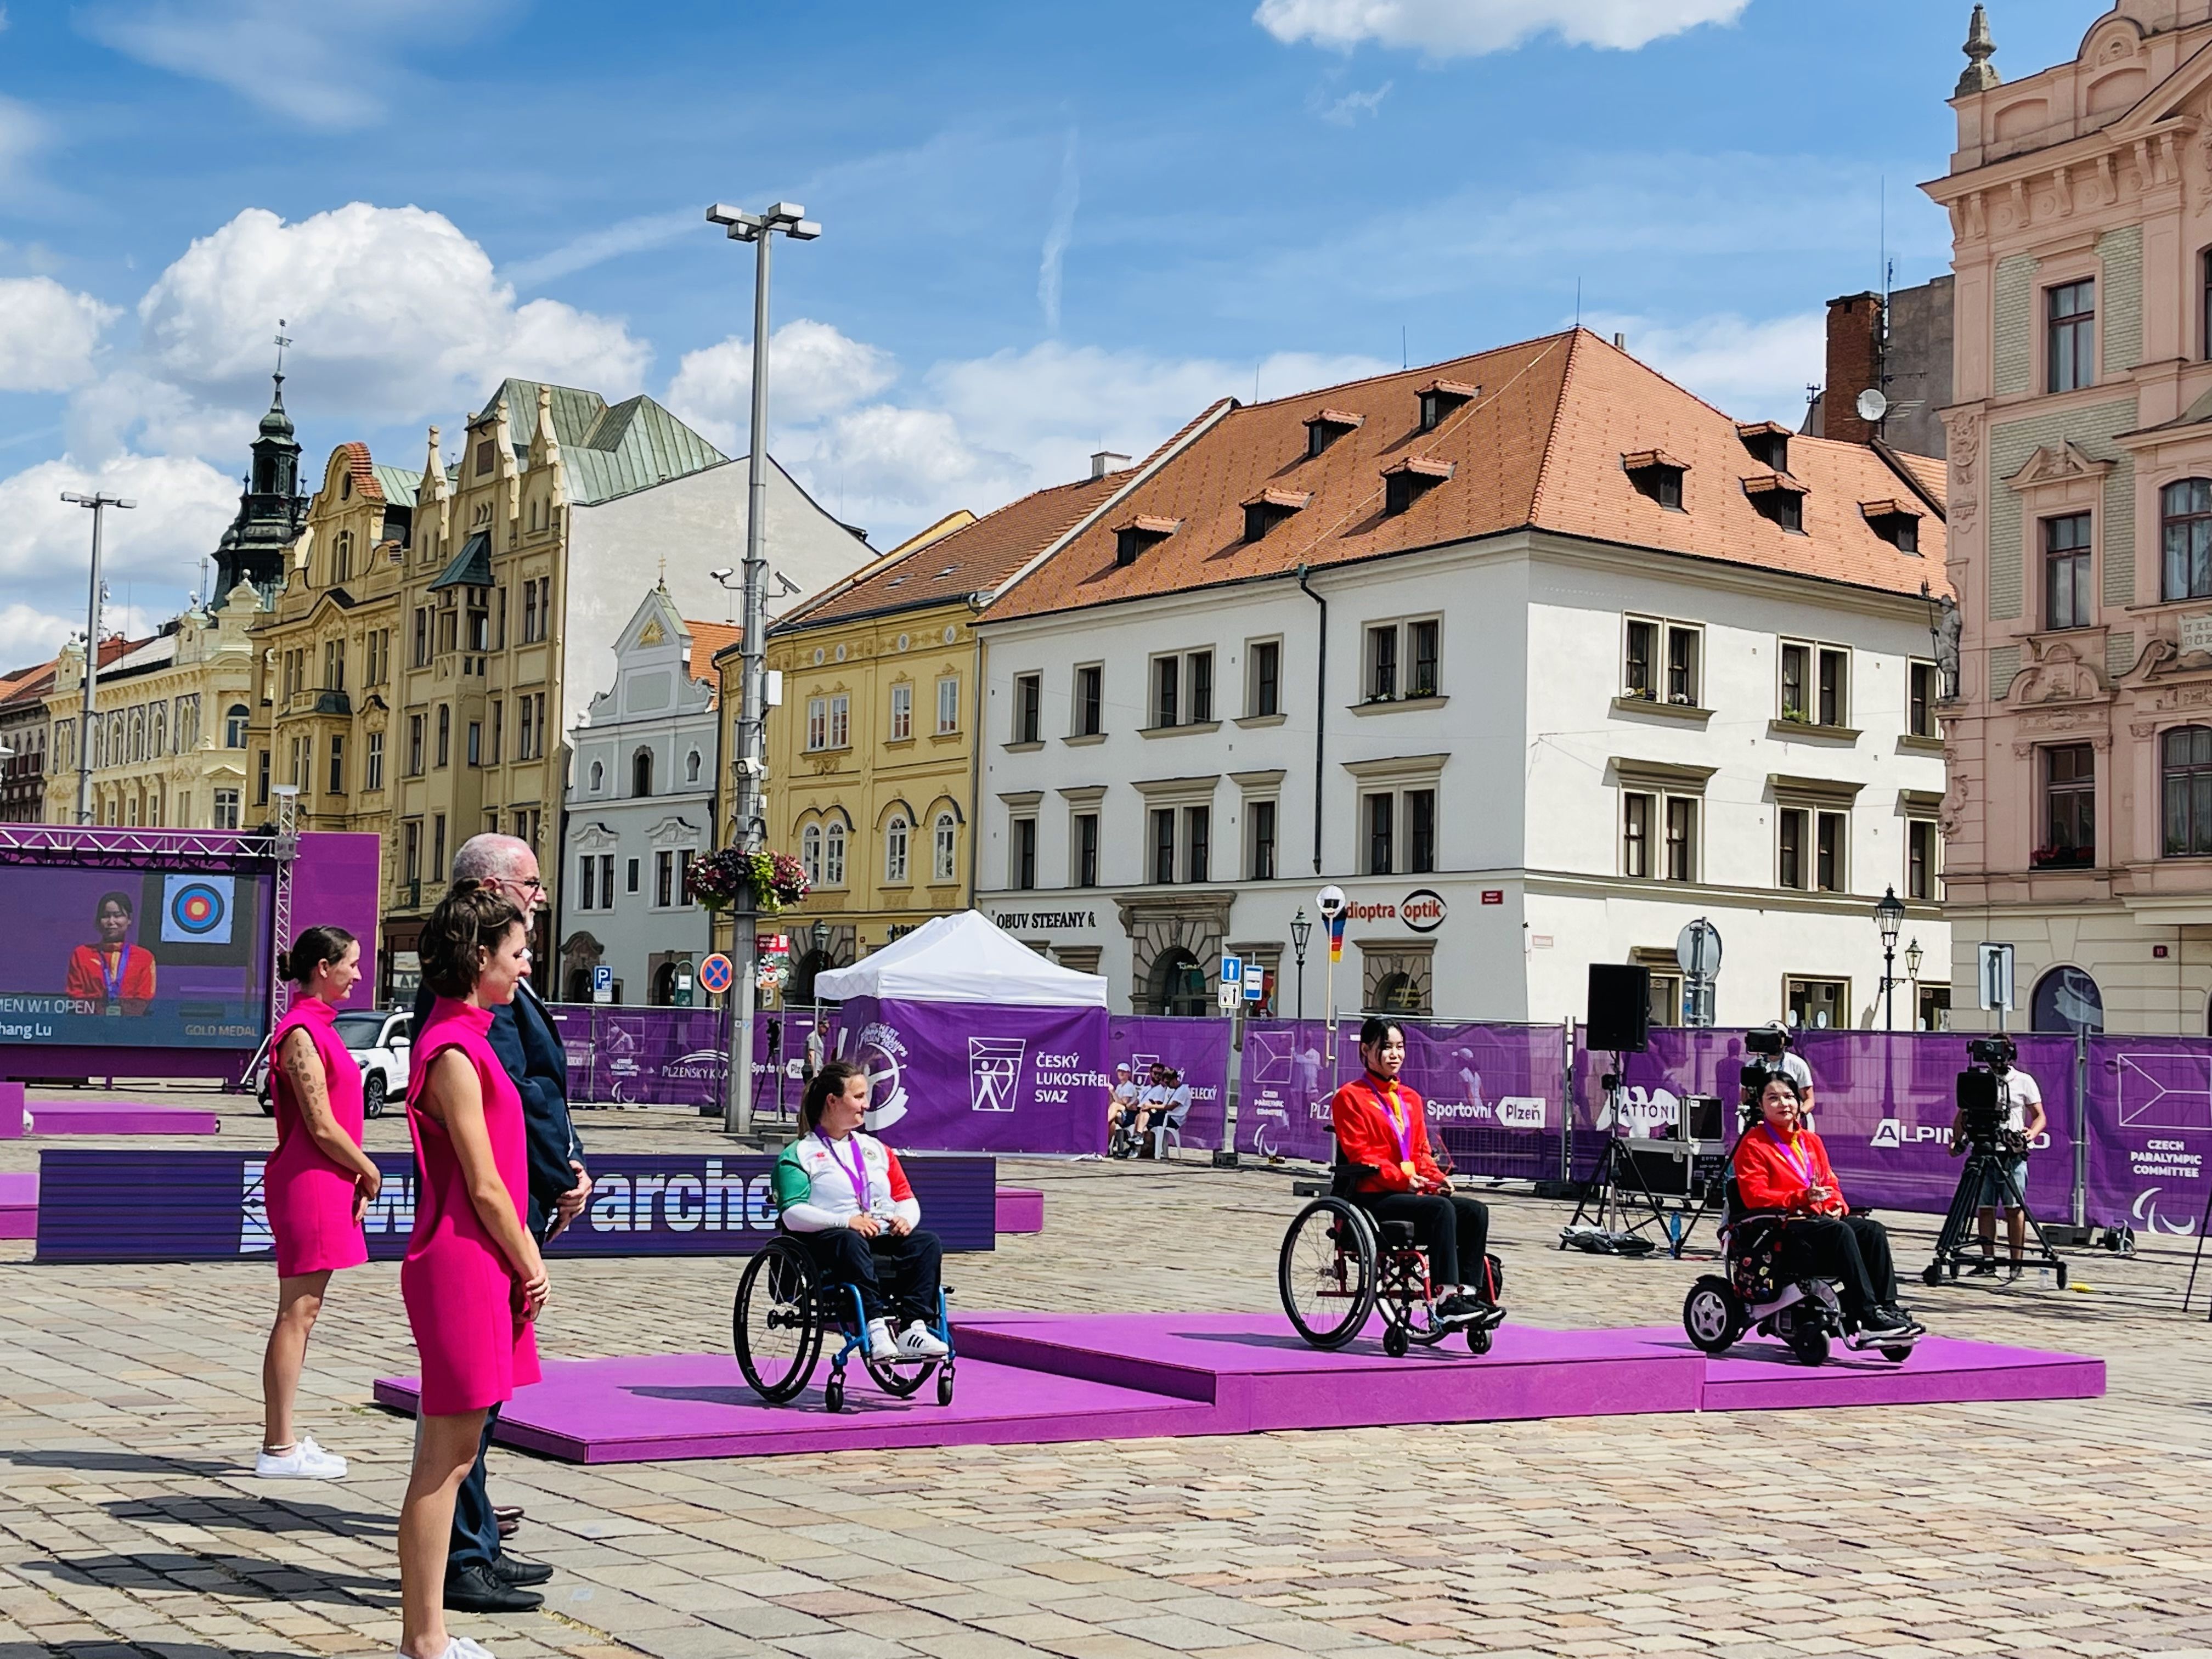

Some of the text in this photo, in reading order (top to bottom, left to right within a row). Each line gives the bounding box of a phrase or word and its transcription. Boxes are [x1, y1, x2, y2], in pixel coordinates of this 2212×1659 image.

[1346, 900, 1441, 922] dioptra optik
[997, 911, 1086, 929] OBUV STEFANY
[598, 969, 608, 984] P
[28, 999, 50, 1013] W1
[55, 1000, 95, 1014] OPEN
[36, 1023, 52, 1036] Lu
[185, 1024, 258, 1036] GOLD MEDAL
[1036, 1051, 1080, 1069] ČESKÝ
[1036, 1070, 1110, 1087] LUKOSTŘEL
[1035, 1089, 1069, 1103] SVAZ
[1426, 1099, 1492, 1120] Sportovní
[1506, 1104, 1540, 1120] Plzeň
[1621, 1103, 1675, 1120] ATTONI
[2147, 1139, 2185, 1151] CZECH
[2130, 1151, 2203, 1165] PARALYMPIC
[2132, 1164, 2199, 1178] COMMITTEE
